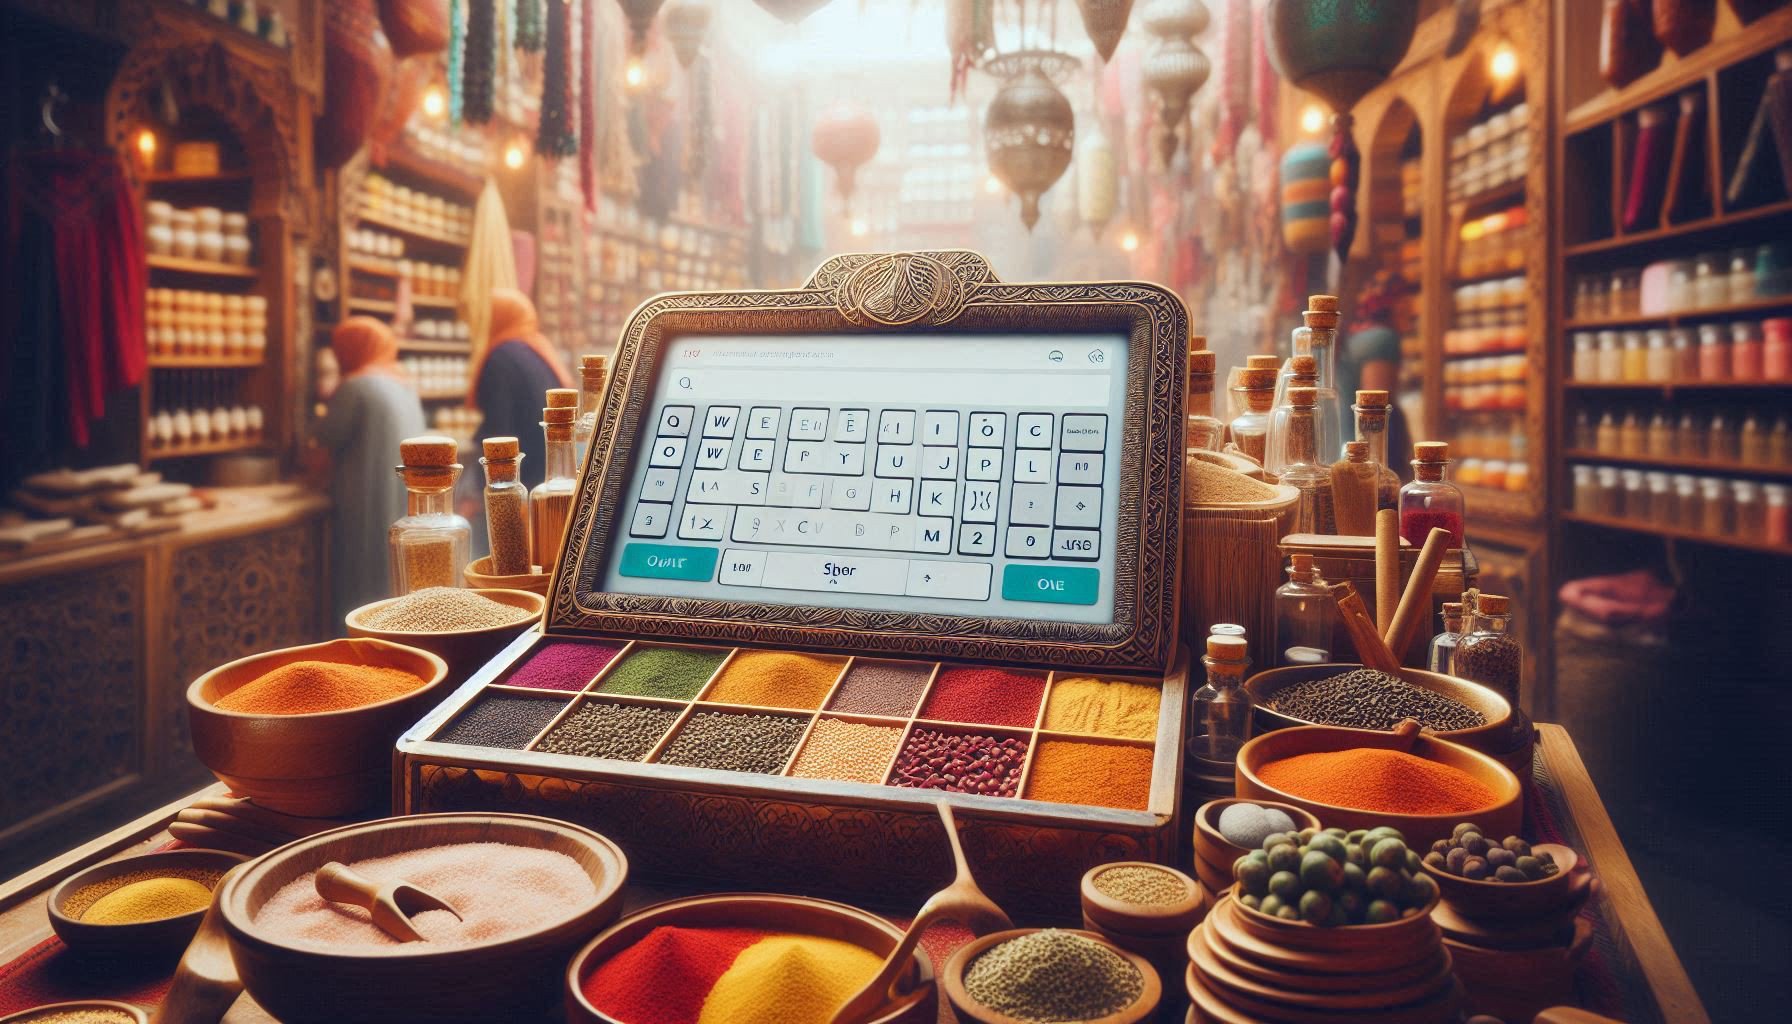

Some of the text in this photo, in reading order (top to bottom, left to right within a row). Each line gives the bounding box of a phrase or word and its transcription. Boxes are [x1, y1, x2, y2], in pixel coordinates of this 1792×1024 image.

[714, 416, 731, 428] W
[761, 417, 771, 429] E
[1030, 425, 1041, 437] C
[707, 447, 722, 460] W
[892, 456, 903, 468] U
[939, 457, 950, 470] J
[981, 459, 991, 472] P
[1029, 460, 1037, 473] L
[751, 482, 760, 495] S
[890, 489, 901, 502] H
[931, 491, 943, 505] K
[797, 521, 808, 534] C
[924, 529, 940, 543] M
[972, 531, 983, 545] 2
